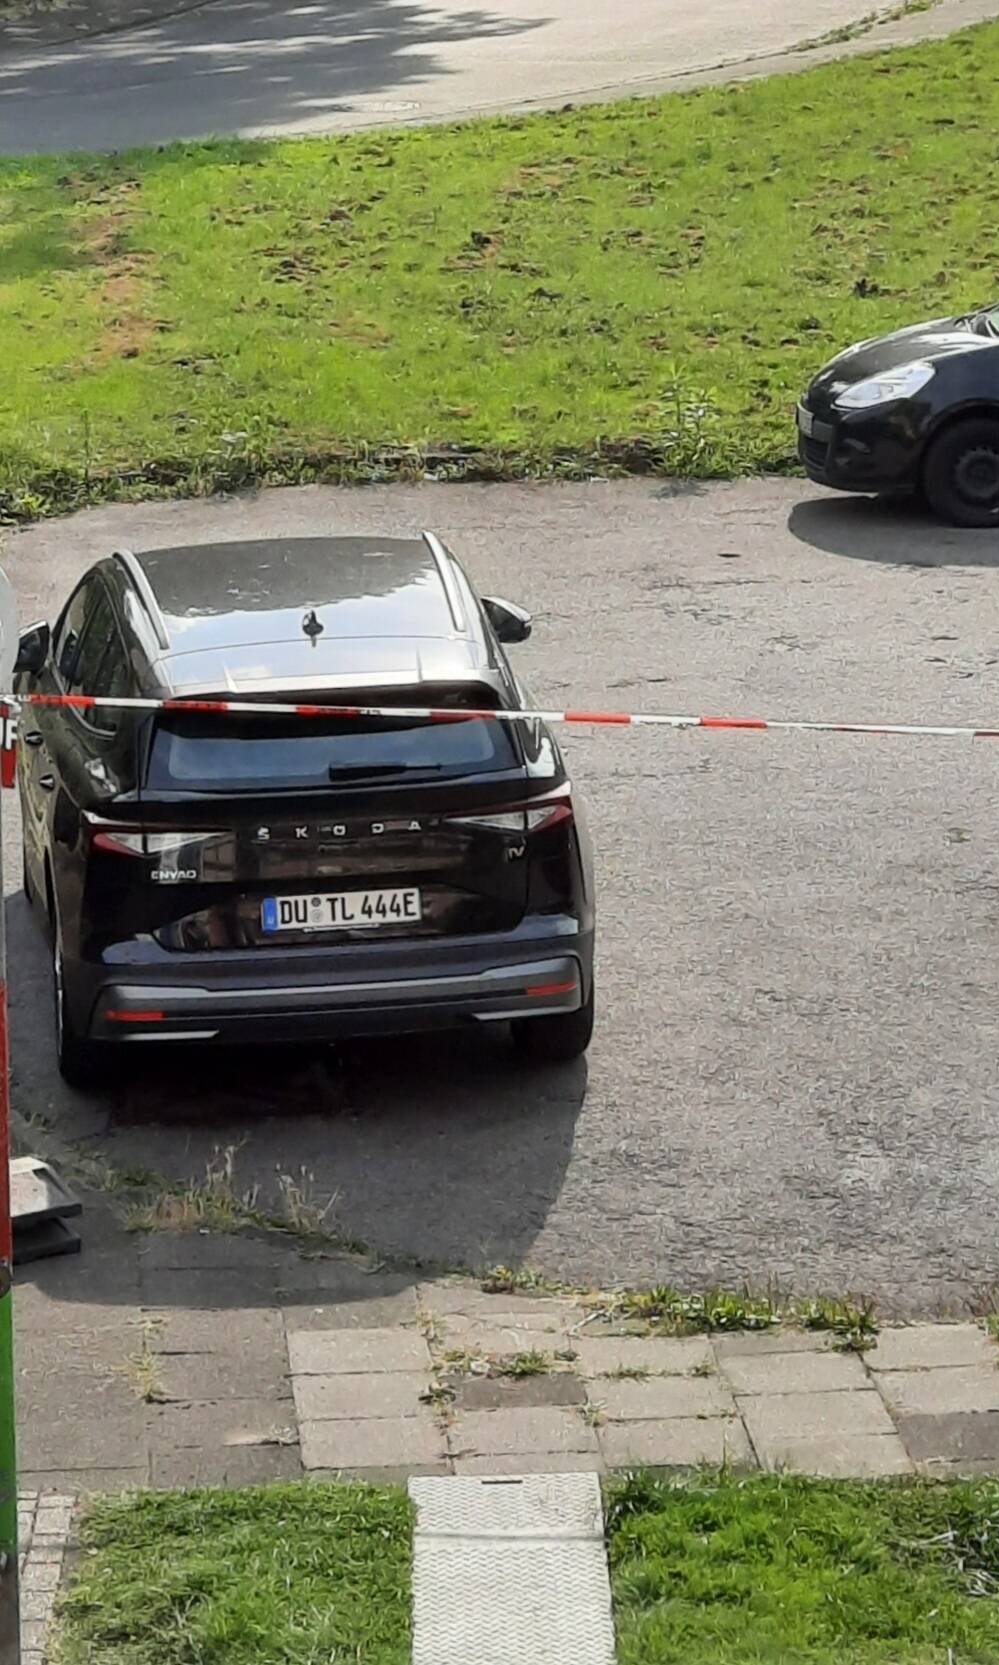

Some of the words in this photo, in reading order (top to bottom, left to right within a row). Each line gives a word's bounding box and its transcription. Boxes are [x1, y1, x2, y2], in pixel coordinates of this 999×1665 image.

[279, 899, 308, 924] DU
[326, 897, 355, 922] TL
[361, 892, 417, 919] 444E
